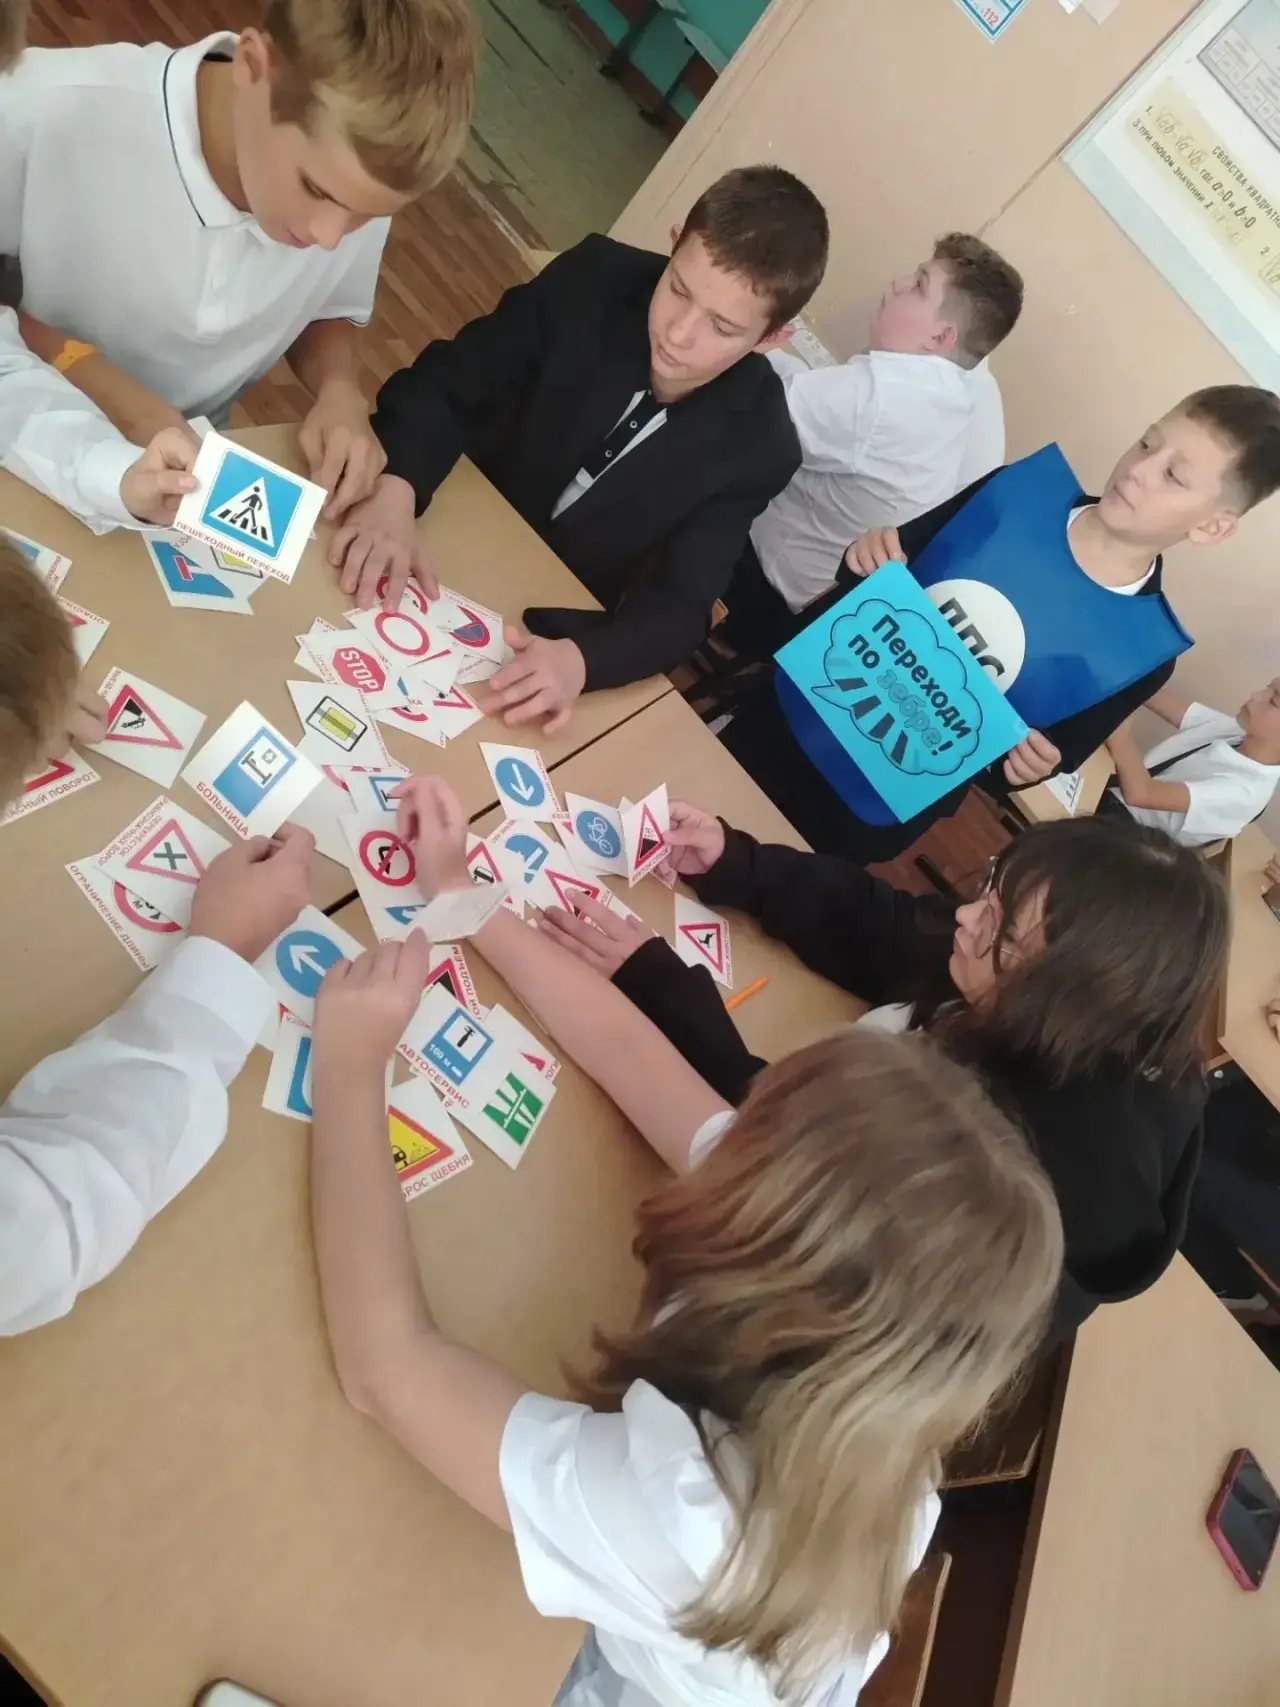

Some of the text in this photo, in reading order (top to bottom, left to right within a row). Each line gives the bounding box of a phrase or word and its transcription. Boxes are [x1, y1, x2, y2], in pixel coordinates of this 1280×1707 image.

[176, 520, 245, 560] ПЕШЕХОДНЫЙ
[246, 554, 290, 583] ПЕРЕХОД
[340, 650, 379, 694] STOP
[847, 634, 954, 757] по зебре!
[872, 614, 971, 738] Переходи
[47, 771, 97, 800] ПОВОРОТ
[196, 781, 250, 837] БОЛЬНИЦА
[69, 863, 151, 970] ОГРАНИЧЕНИЕ ДЛИНЫ
[399, 1042, 471, 1110] АВТОСЕРВИС
[430, 1153, 471, 1184] ЩЕБНЯ
